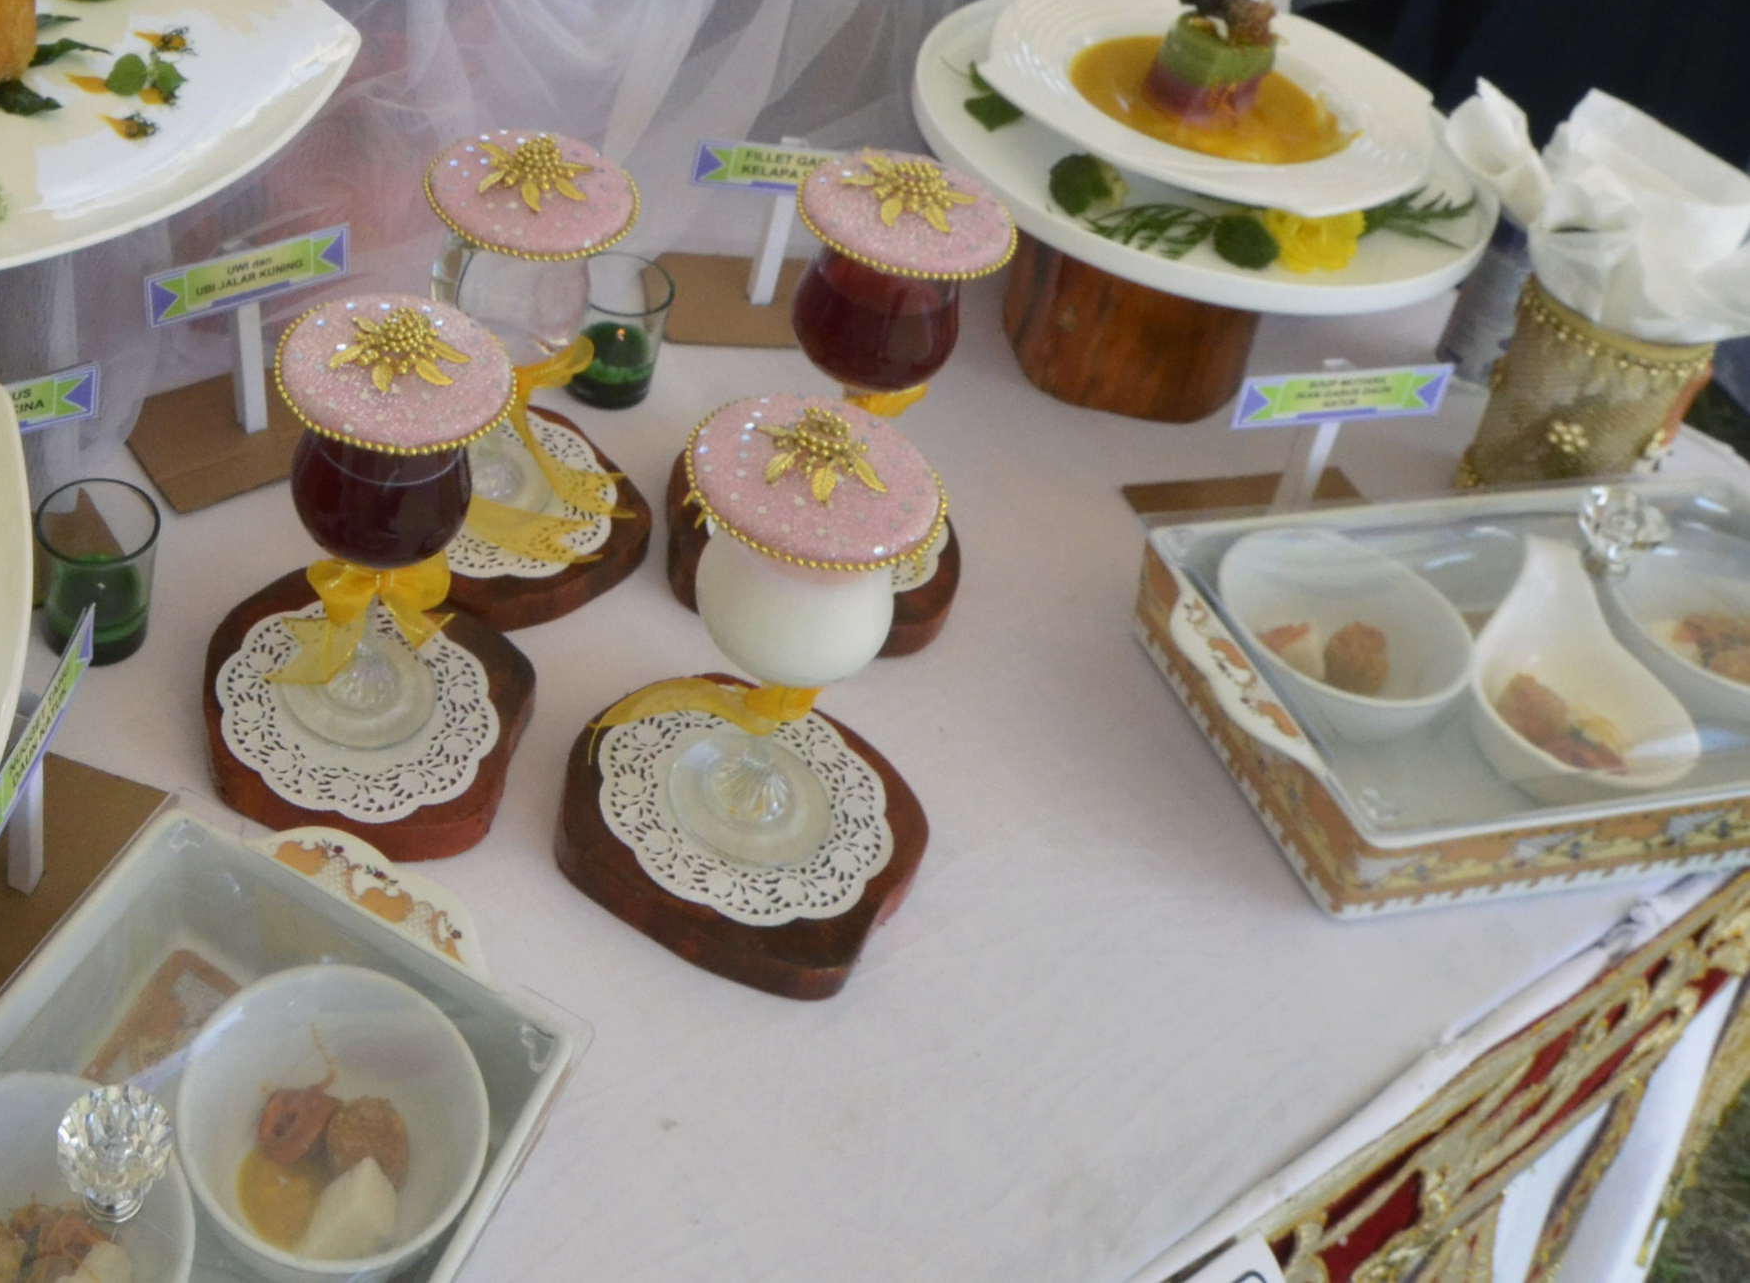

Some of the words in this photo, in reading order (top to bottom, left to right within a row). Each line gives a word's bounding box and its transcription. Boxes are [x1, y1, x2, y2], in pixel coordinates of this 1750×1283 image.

[741, 164, 799, 179] KELAPA
[195, 283, 217, 297] UBI
[219, 272, 257, 291] JALAR
[259, 259, 304, 278] KUNING
